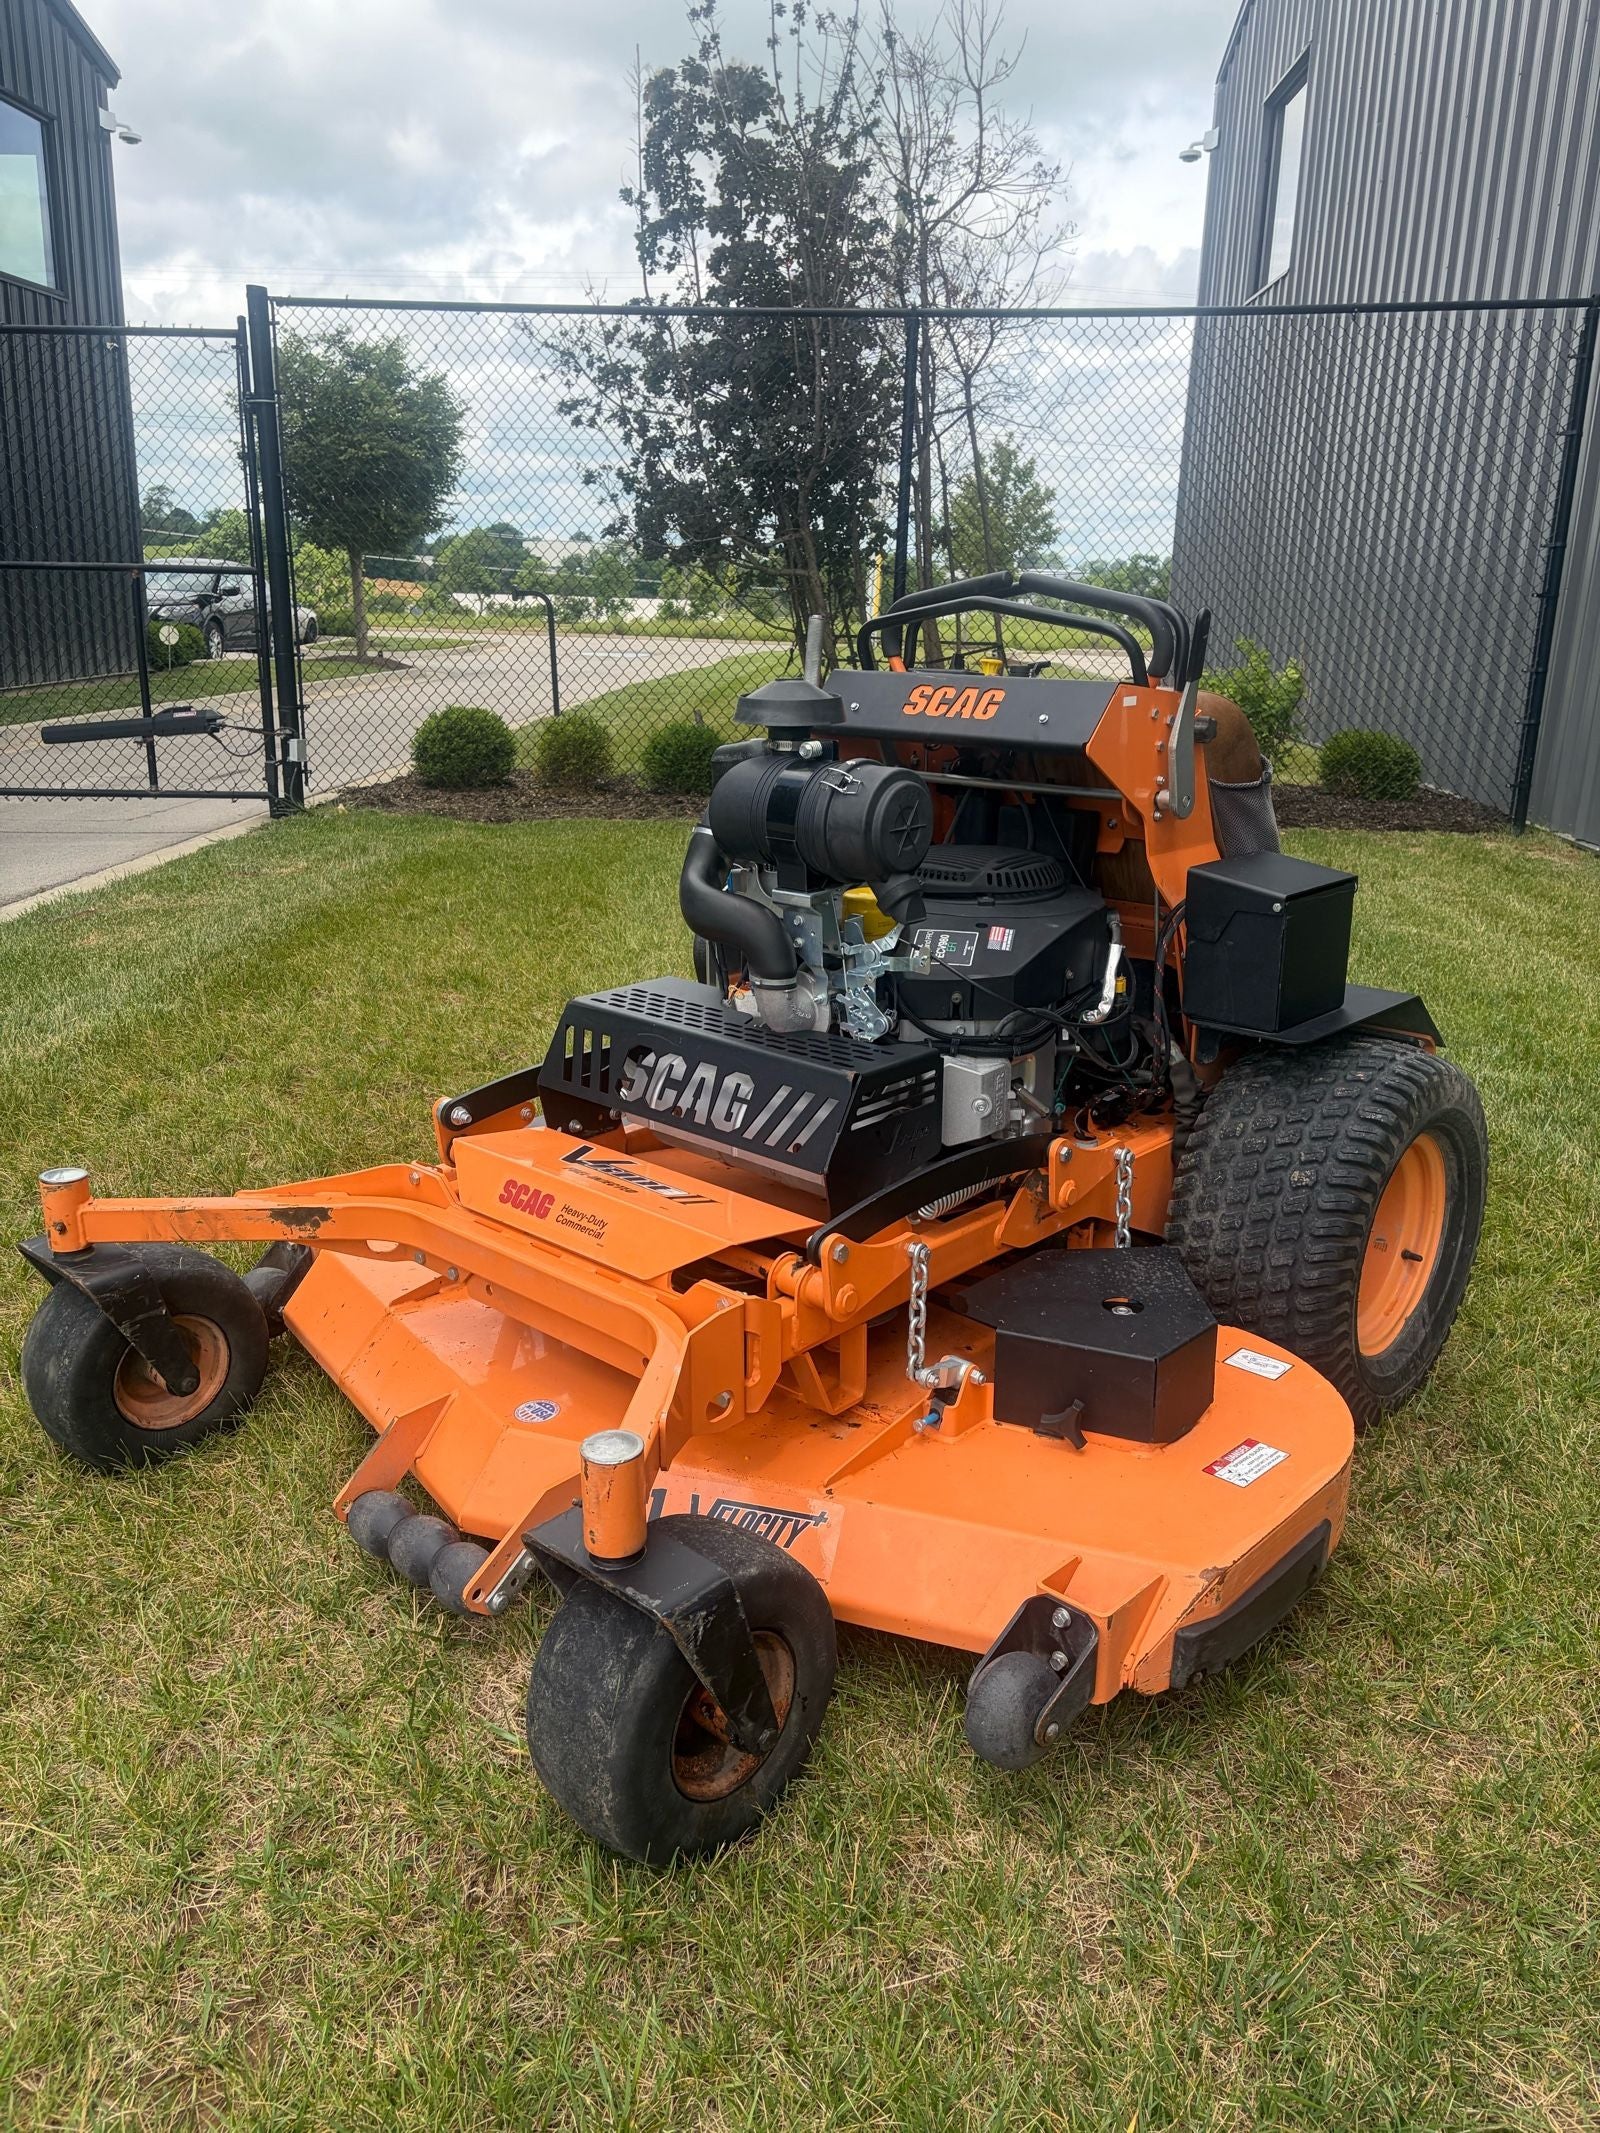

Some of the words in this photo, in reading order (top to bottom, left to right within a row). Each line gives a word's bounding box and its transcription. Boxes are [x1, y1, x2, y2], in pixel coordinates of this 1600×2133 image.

[902, 684, 1006, 720] SCAG
[935, 934, 950, 959] ECV980
[615, 1045, 755, 1133] SCAG
[499, 1179, 555, 1220] SCAG
[556, 1214, 605, 1240] Commercial
[561, 1203, 608, 1229] Heavy-Duty
[531, 1406, 553, 1420] USA
